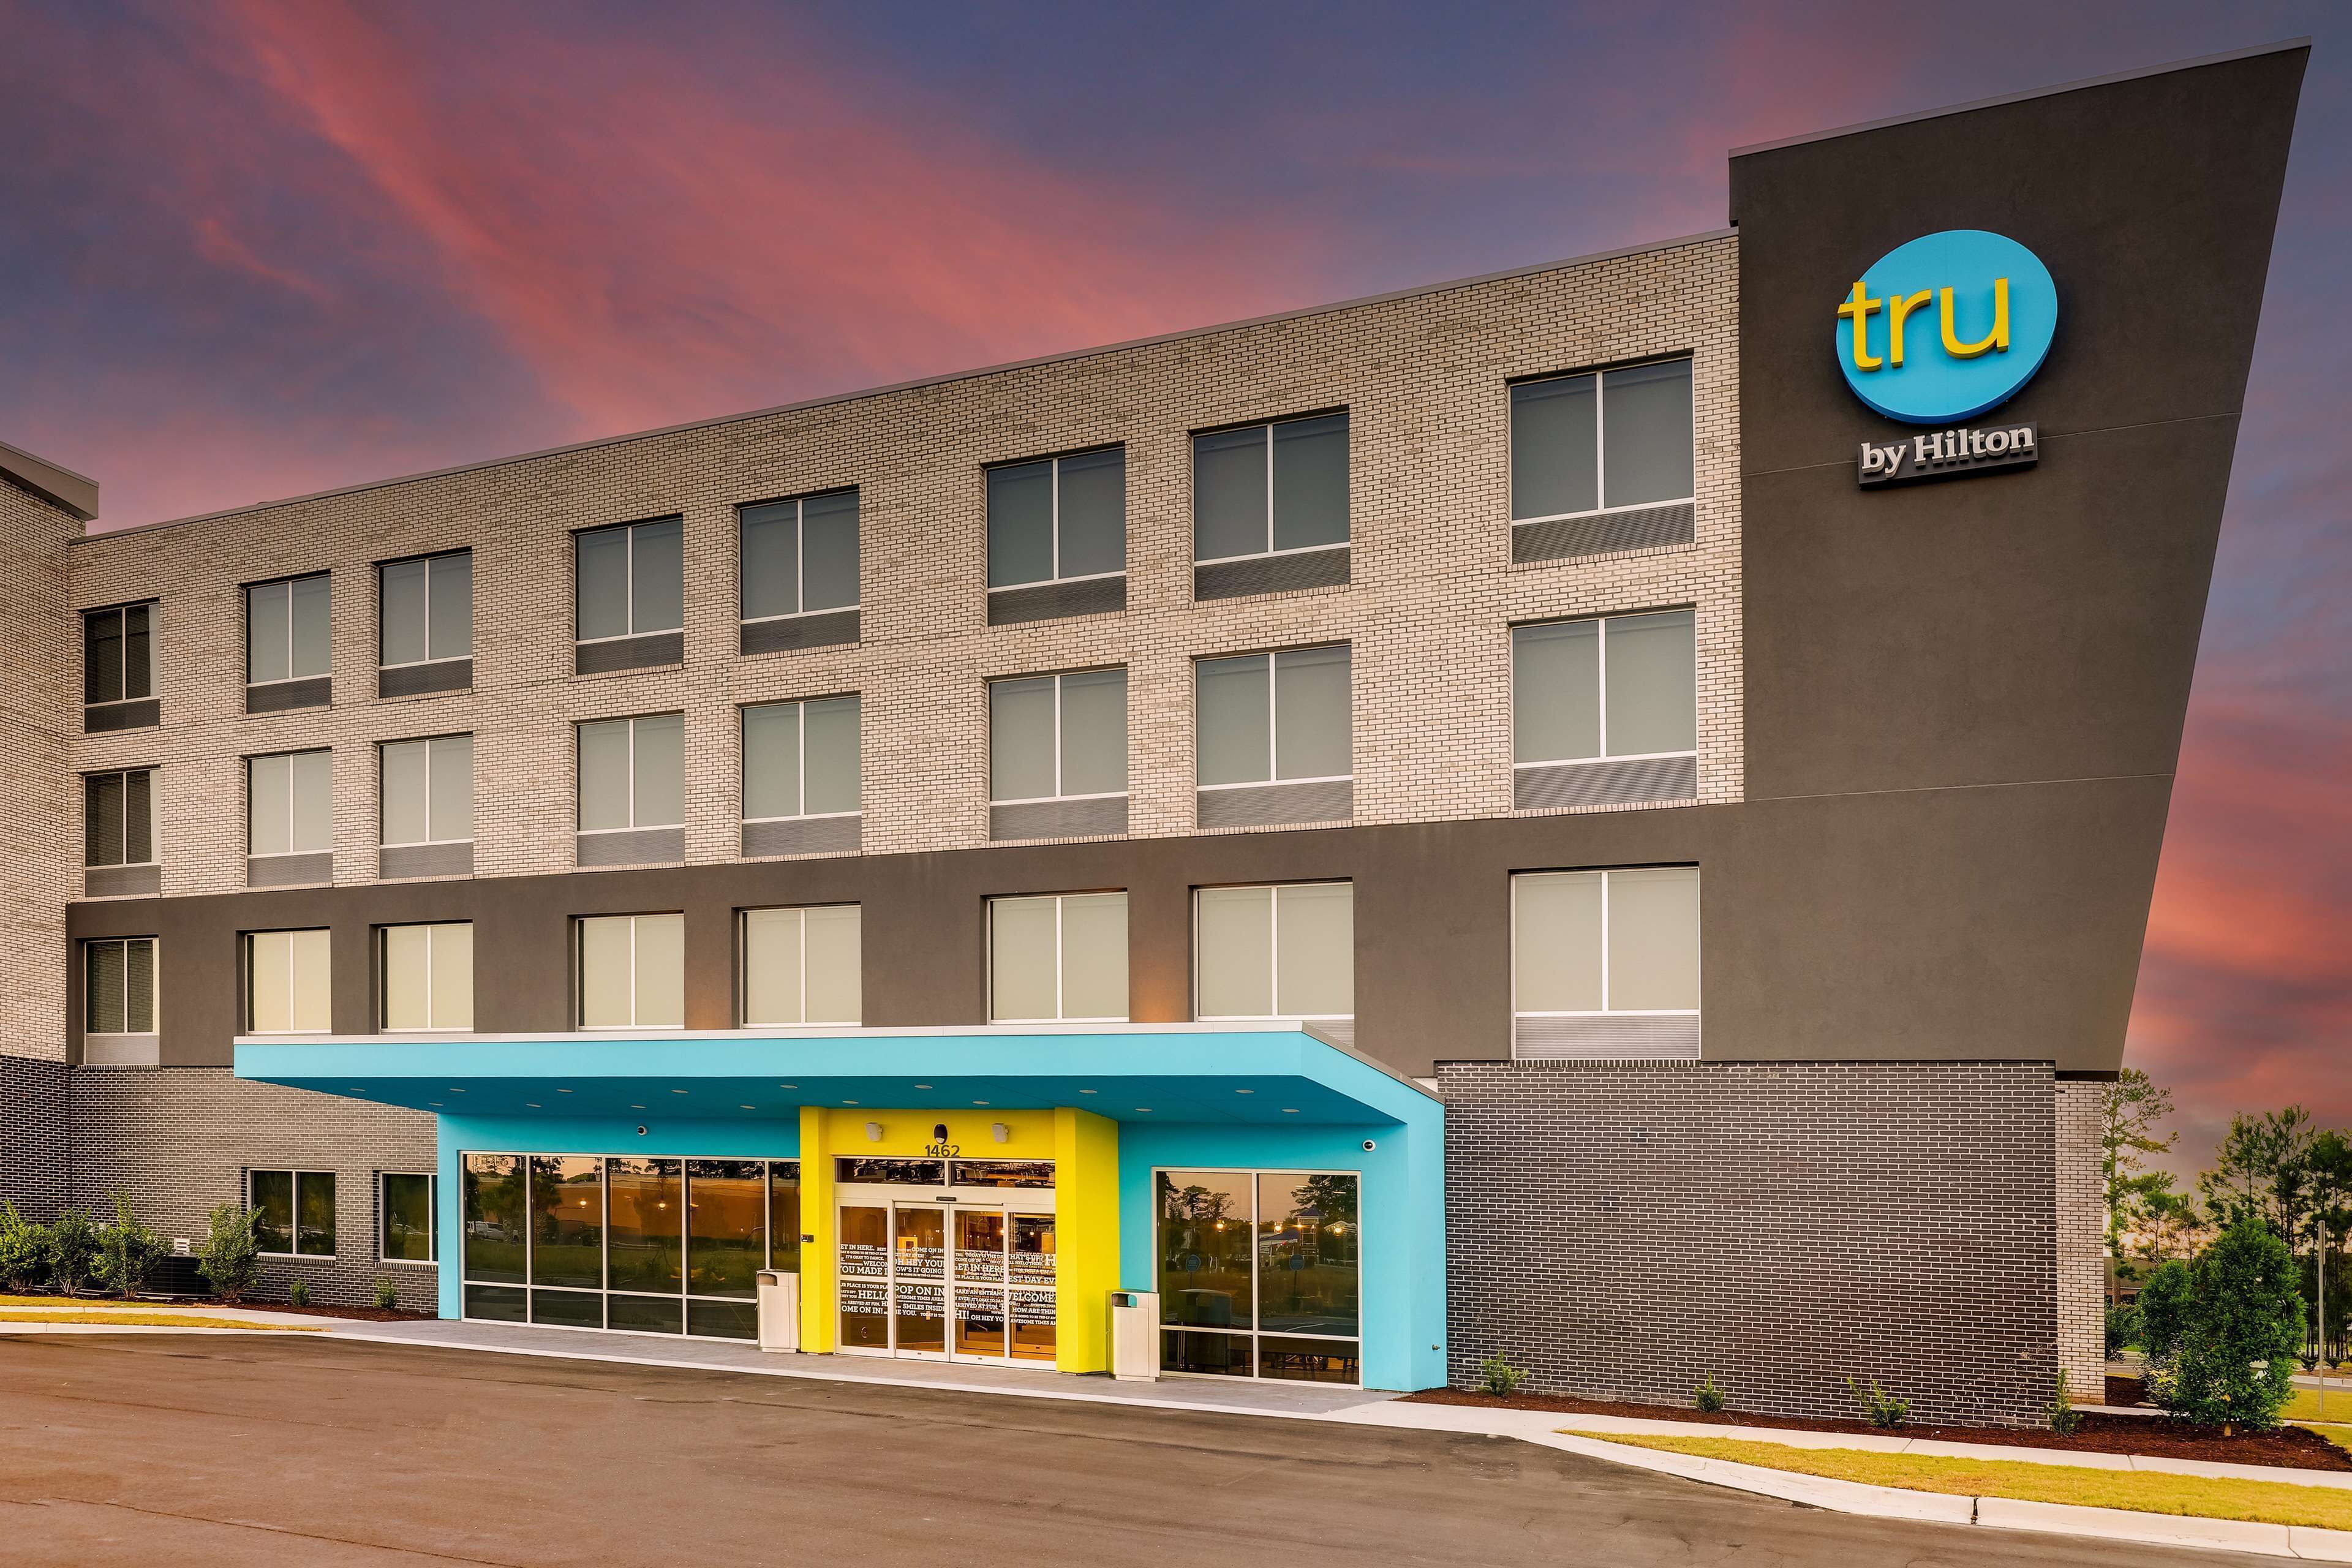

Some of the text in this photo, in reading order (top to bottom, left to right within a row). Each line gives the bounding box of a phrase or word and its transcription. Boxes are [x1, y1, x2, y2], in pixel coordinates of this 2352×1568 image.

[1838, 277, 2009, 372] tru
[1861, 427, 2035, 478] by Hilton
[925, 1145, 960, 1158] 1462
[916, 1286, 932, 1295] ON
[955, 1310, 970, 1319] HI!
